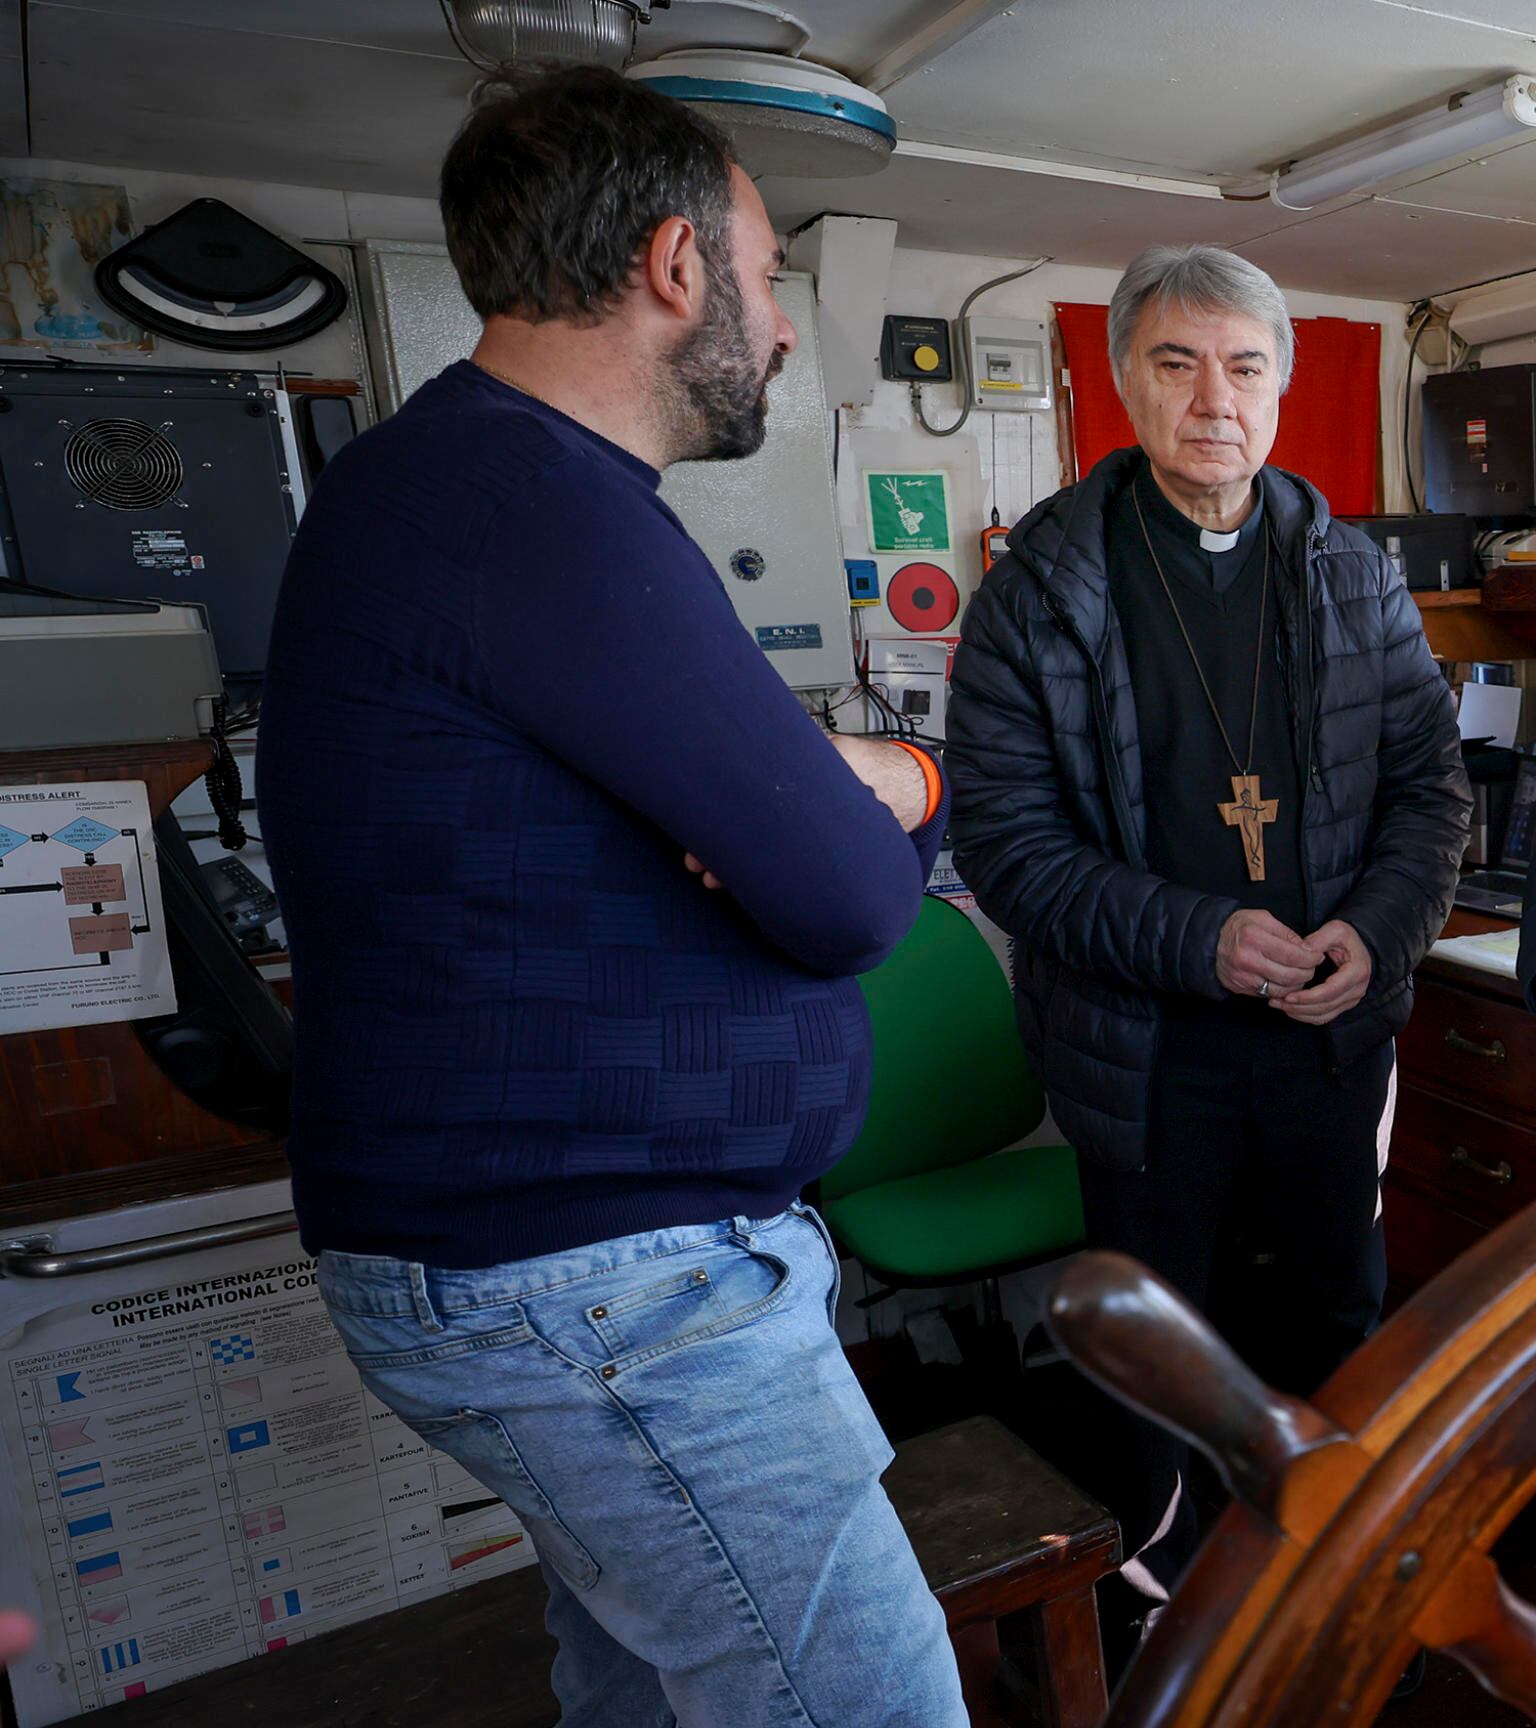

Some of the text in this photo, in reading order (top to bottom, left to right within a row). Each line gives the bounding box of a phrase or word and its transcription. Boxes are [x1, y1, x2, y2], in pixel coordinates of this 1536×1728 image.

[48, 791, 81, 800] ALERT
[100, 996, 133, 1006] ELECTRIC
[91, 1290, 170, 1316] CODICE
[112, 1282, 278, 1328] INTERNATIONAL
[14, 1336, 135, 1369] SEGNALI AD UNA LETTERA
[16, 1347, 123, 1377] SINGLE LETTER SIGNAL
[379, 1447, 425, 1463] KARTEFOUR
[388, 1487, 428, 1503] PANTAFIVE
[411, 1523, 417, 1531] 6
[417, 1562, 423, 1570] 7
